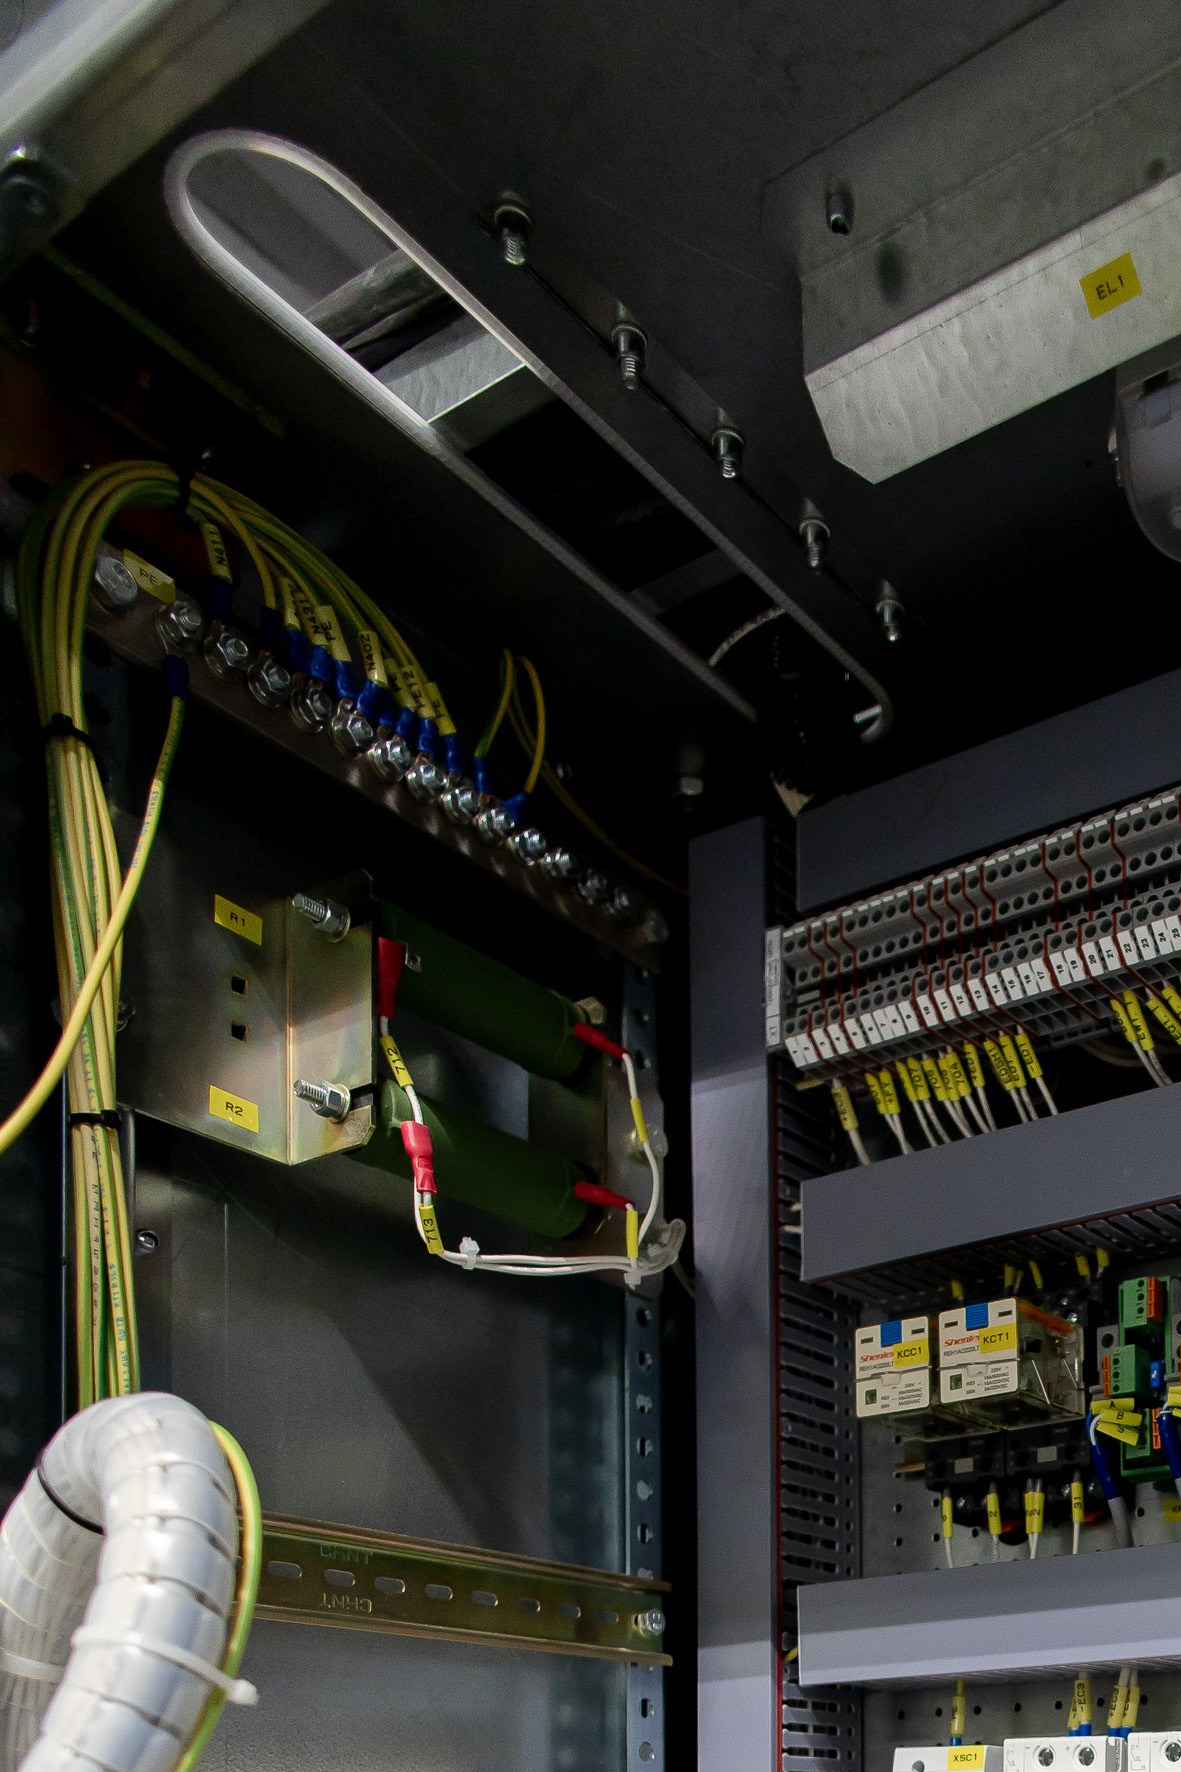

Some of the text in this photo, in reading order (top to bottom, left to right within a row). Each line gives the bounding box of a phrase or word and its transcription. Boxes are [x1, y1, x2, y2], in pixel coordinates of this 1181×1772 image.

[1095, 274, 1125, 301] EL1
[322, 620, 337, 643] PE
[229, 912, 246, 928] R1
[387, 1046, 407, 1075] 712
[224, 1100, 244, 1118] R2
[423, 1216, 438, 1245] 713
[982, 1331, 1011, 1345] KCT1
[896, 1346, 923, 1360] KCC1
[952, 1753, 978, 1763] XSC1
